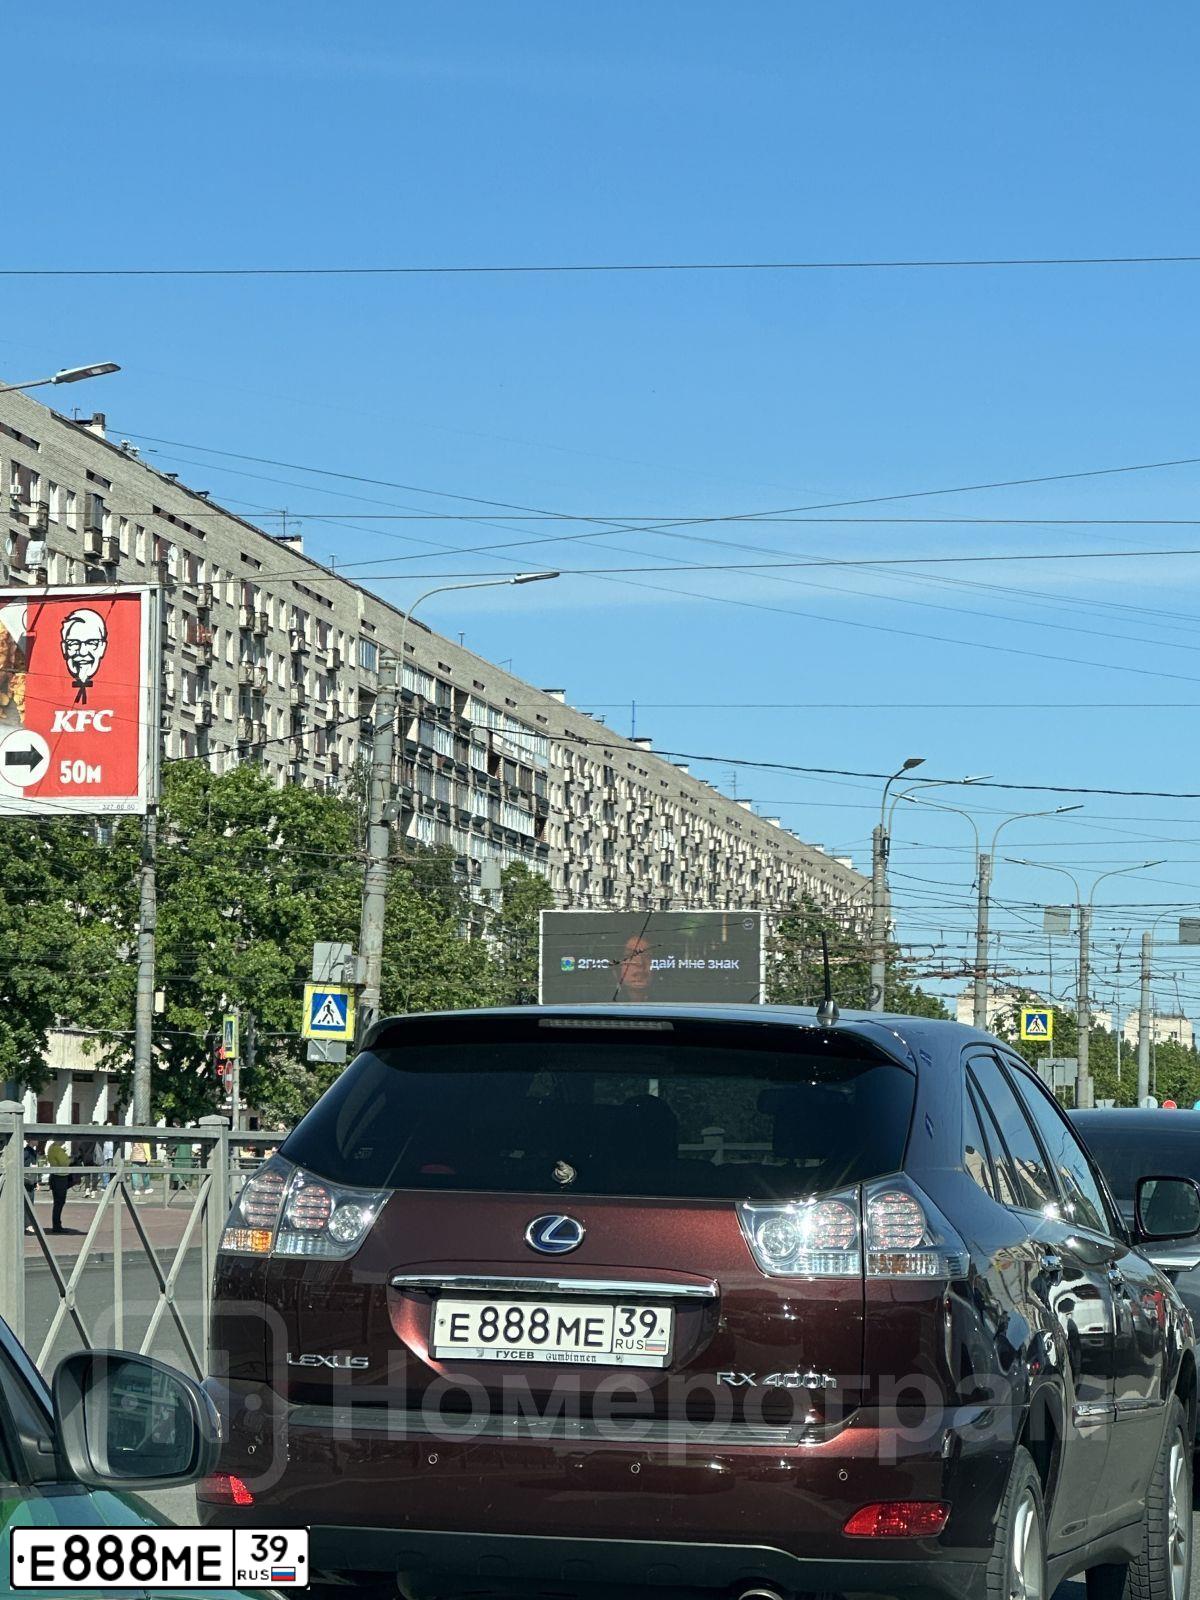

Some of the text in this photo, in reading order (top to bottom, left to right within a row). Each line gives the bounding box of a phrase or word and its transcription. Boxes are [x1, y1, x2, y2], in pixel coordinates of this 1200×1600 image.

[50, 709, 114, 733] KFC
[649, 955, 675, 971] дай
[678, 959, 705, 969] мне
[707, 959, 739, 969] знак
[618, 1308, 658, 1339] 39
[615, 1338, 644, 1350] RUS
[286, 1352, 369, 1369] LEXUS
[495, 1350, 535, 1360] ГУСЕВ
[716, 1371, 837, 1389] RX 400h
